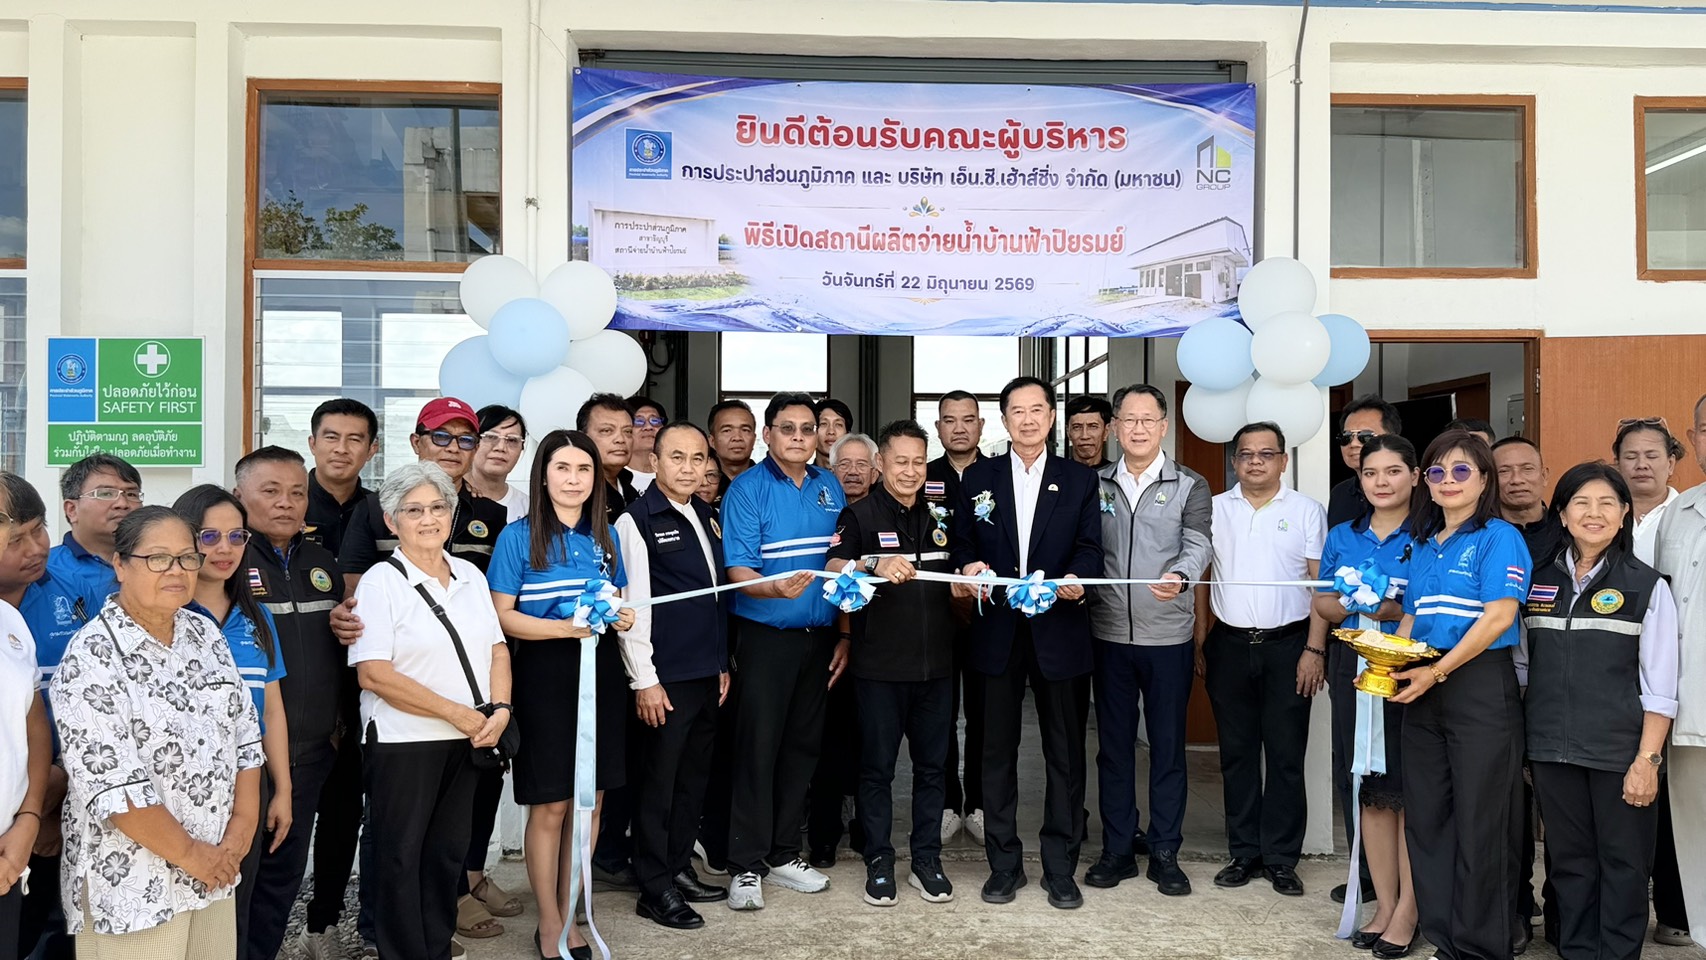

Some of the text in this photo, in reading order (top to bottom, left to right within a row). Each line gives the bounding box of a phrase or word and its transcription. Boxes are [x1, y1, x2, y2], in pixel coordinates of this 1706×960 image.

[735, 114, 1127, 159] ยินดีต้อนรับคณะผู้บริหาร
[681, 163, 856, 189] การประปาส่วนภูมิภาค
[862, 170, 892, 185] และ
[898, 166, 944, 186] บริษัท
[1065, 168, 1108, 187] จำกัด
[1114, 169, 1182, 190] (มหาชน)
[1196, 169, 1231, 184] NC
[1196, 183, 1231, 191] GROUP
[743, 219, 1126, 254] พิธีเปิดสถานีผลิตจ่ายน้ำบ้านฟ้าปิยรมย์
[821, 270, 1035, 295] วันจันทร์ที่ 22 มิถุนายน 2569
[102, 382, 198, 399] ปลอดภัยไว้ก่อน
[102, 401, 198, 414] SAFETY FIRST
[68, 429, 179, 446] ปฏิบัติตามกฎ ลดอุบัติภัย
